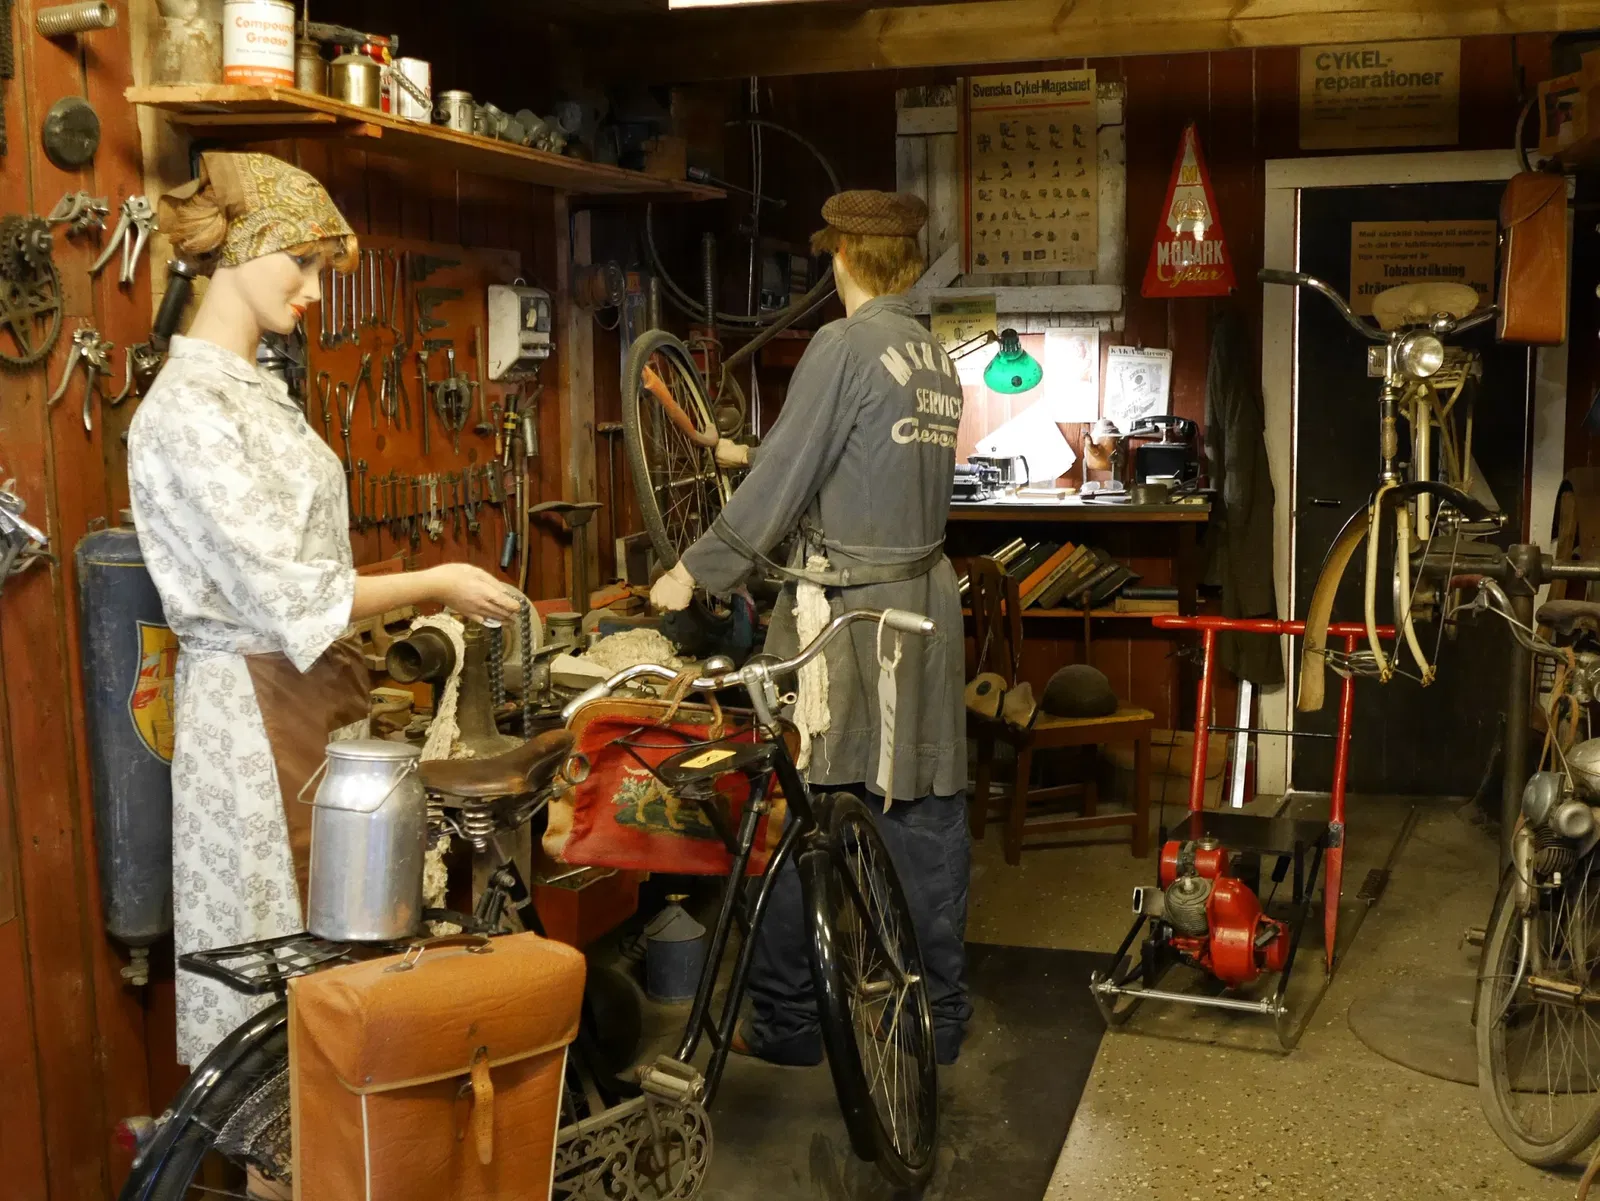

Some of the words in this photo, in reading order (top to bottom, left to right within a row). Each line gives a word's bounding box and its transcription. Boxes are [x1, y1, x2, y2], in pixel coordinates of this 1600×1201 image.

[246, 32, 288, 47] Grease
[1315, 50, 1392, 71] CYKEL-
[973, 83, 1012, 98] Svenska
[1014, 77, 1090, 97] Cykel-Magasinet
[1315, 70, 1444, 91] reparationer
[1181, 166, 1198, 182] M
[1157, 240, 1224, 265] MONARK
[1157, 264, 1224, 288] Cyklar
